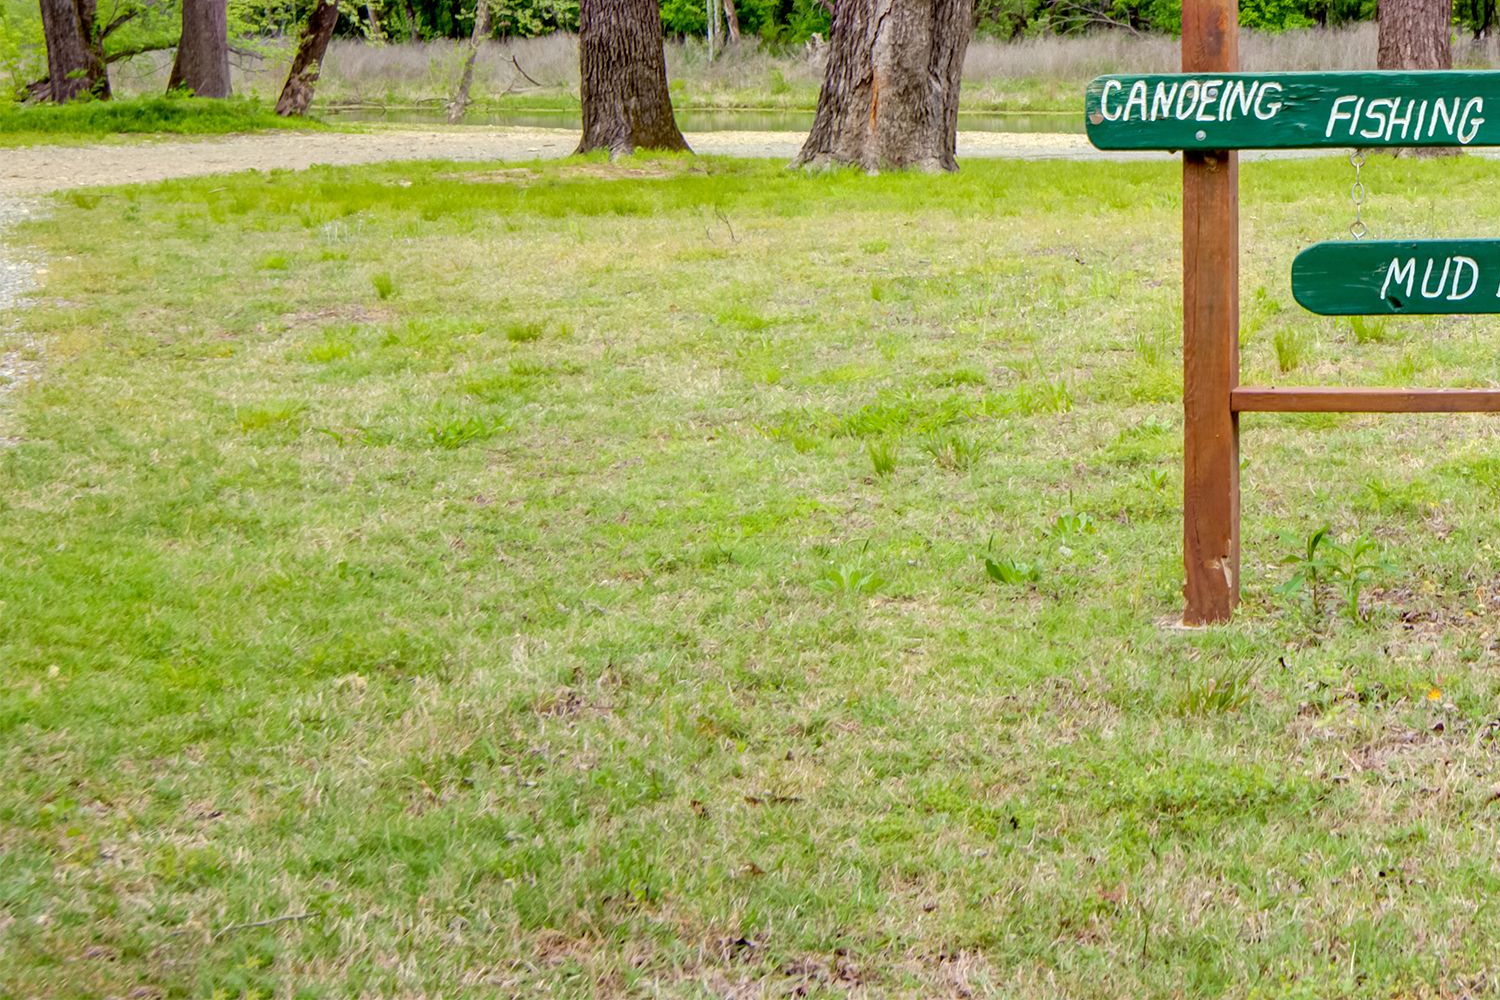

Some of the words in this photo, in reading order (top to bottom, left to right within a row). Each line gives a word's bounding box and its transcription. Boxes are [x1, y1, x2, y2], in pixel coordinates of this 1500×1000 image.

[1100, 79, 1283, 122] CANOEING
[1325, 95, 1485, 145] FISHING
[1380, 255, 1480, 300] MUD
